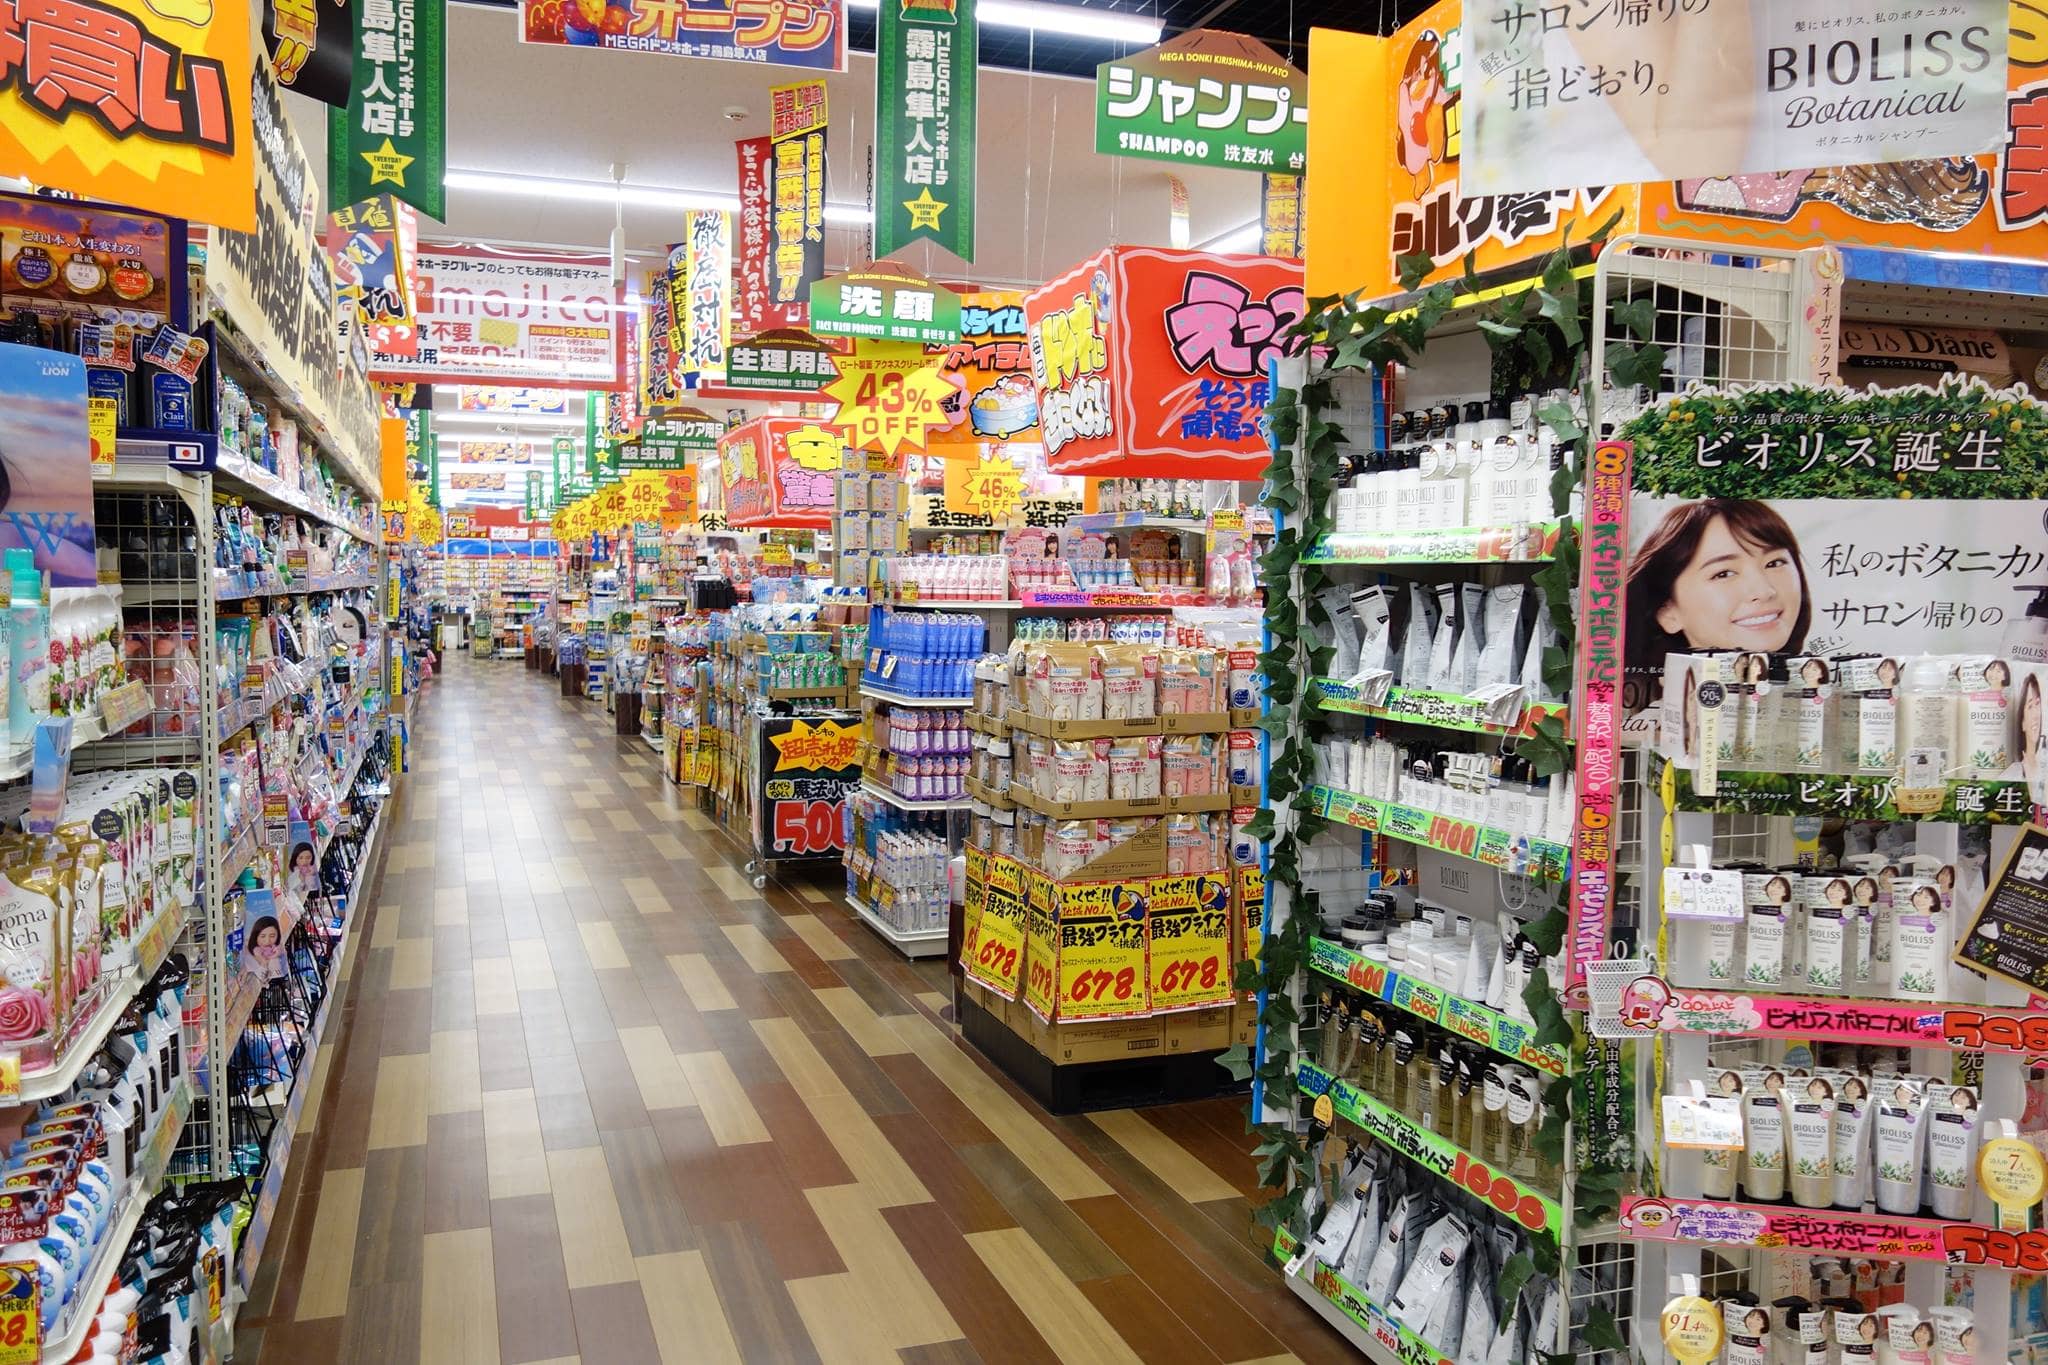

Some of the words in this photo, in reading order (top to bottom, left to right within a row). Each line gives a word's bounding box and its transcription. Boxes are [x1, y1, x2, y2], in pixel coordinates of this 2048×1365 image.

[1159, 52, 1184, 63] MEGA
[1186, 53, 1213, 65] DONKI
[1215, 55, 1289, 78] KIRISHIMA-HAYATO
[1767, 26, 1991, 93] BIOLISS
[1508, 59, 1670, 112] 指どおり。
[1785, 82, 1967, 129] Botanical
[904, 28, 935, 186] 霧島隼人店
[1119, 133, 1209, 158] SHAMPOO
[42, 367, 70, 377] LION
[856, 372, 932, 414] 43%
[862, 417, 919, 435] OFF
[1697, 429, 2004, 474] ビオリス誕生
[979, 477, 1016, 498] 46%
[1821, 599, 2004, 630] サロン帰りの
[1453, 1151, 1548, 1231] 1000
